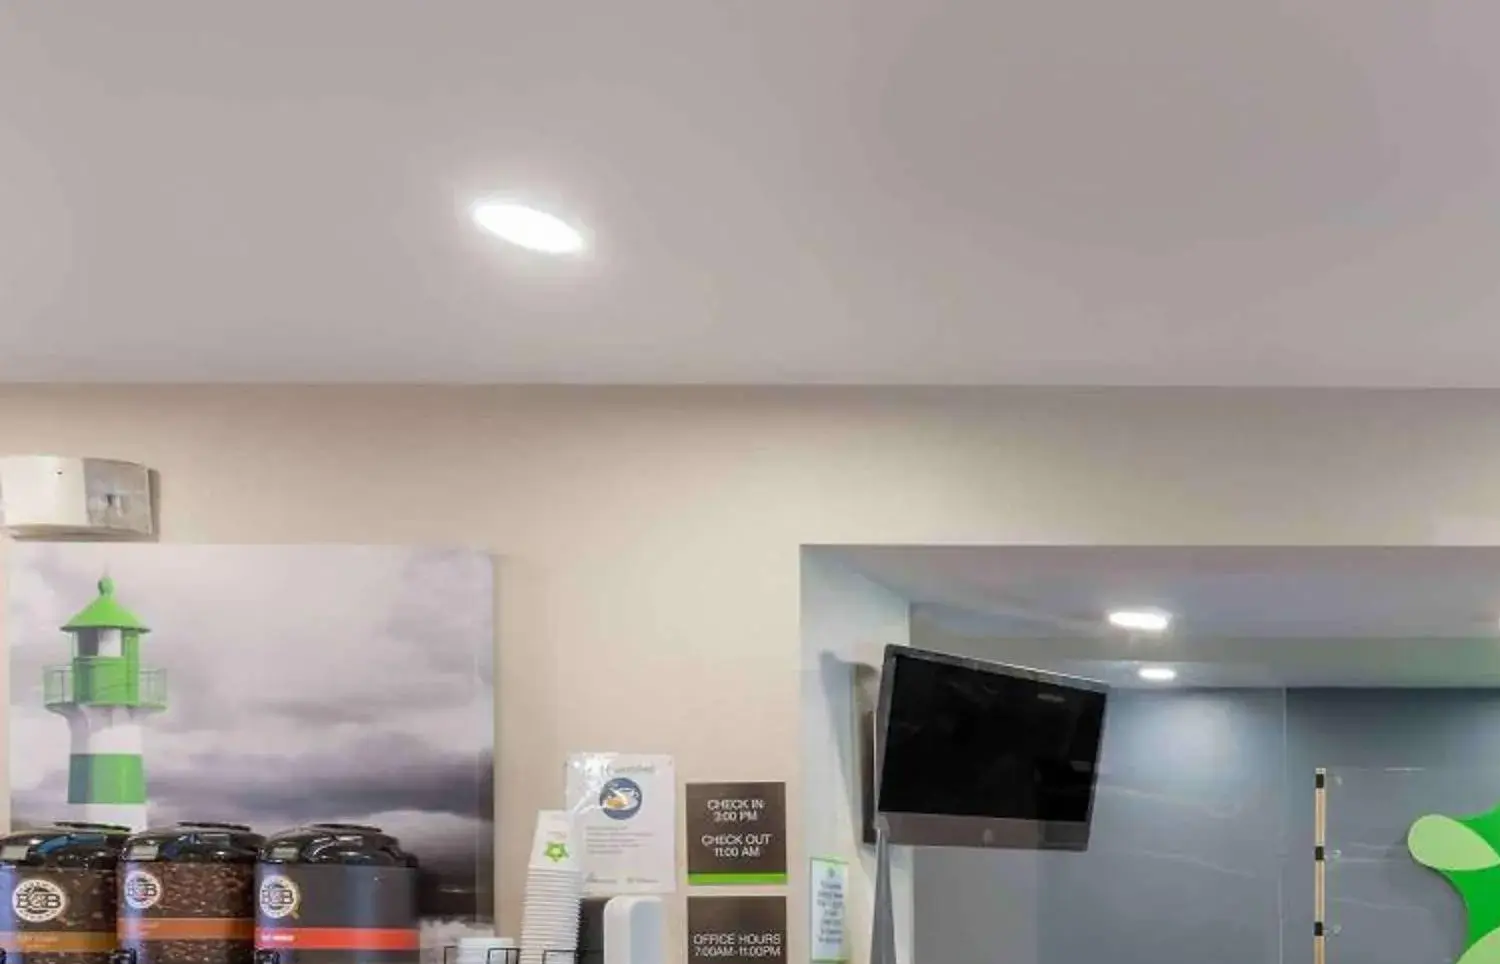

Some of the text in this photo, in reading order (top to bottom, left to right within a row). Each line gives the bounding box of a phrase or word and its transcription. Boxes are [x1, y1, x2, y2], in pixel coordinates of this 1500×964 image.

[707, 799, 764, 811] CHECK IN
[739, 811, 759, 821] PM
[701, 834, 772, 846] CHECK OUT
[741, 846, 761, 857] AM
[693, 933, 781, 945] OFFICE HOURS
